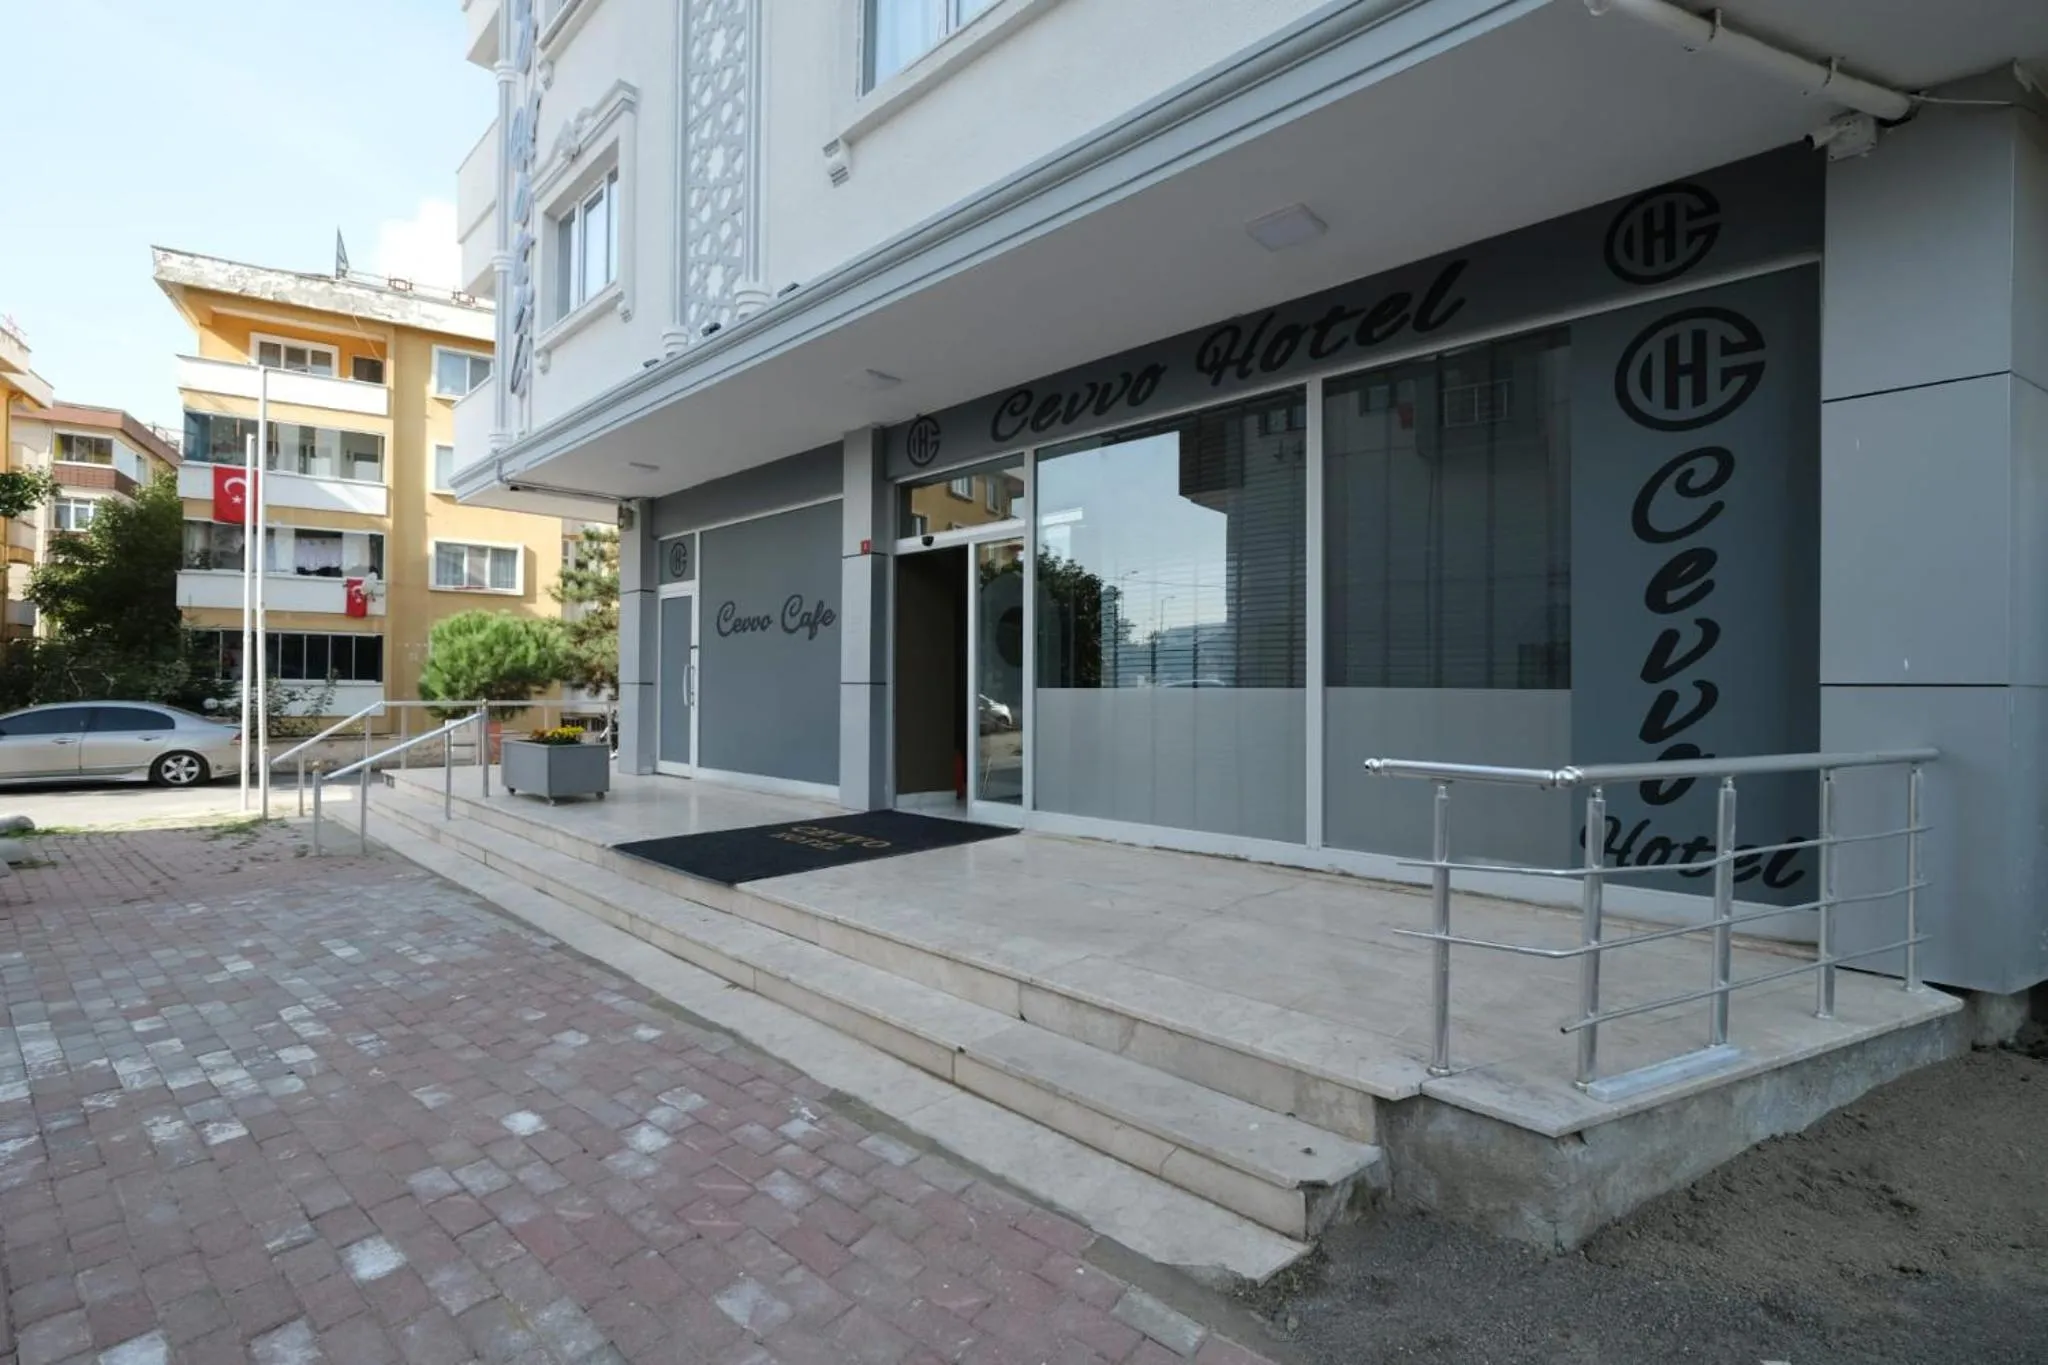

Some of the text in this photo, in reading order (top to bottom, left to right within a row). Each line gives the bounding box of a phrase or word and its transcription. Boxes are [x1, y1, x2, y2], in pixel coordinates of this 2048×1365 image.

[990, 259, 1469, 443] Cevvo Hotel
[716, 594, 836, 640] Cevvo Cafe
[1579, 815, 1806, 889] Hotel
